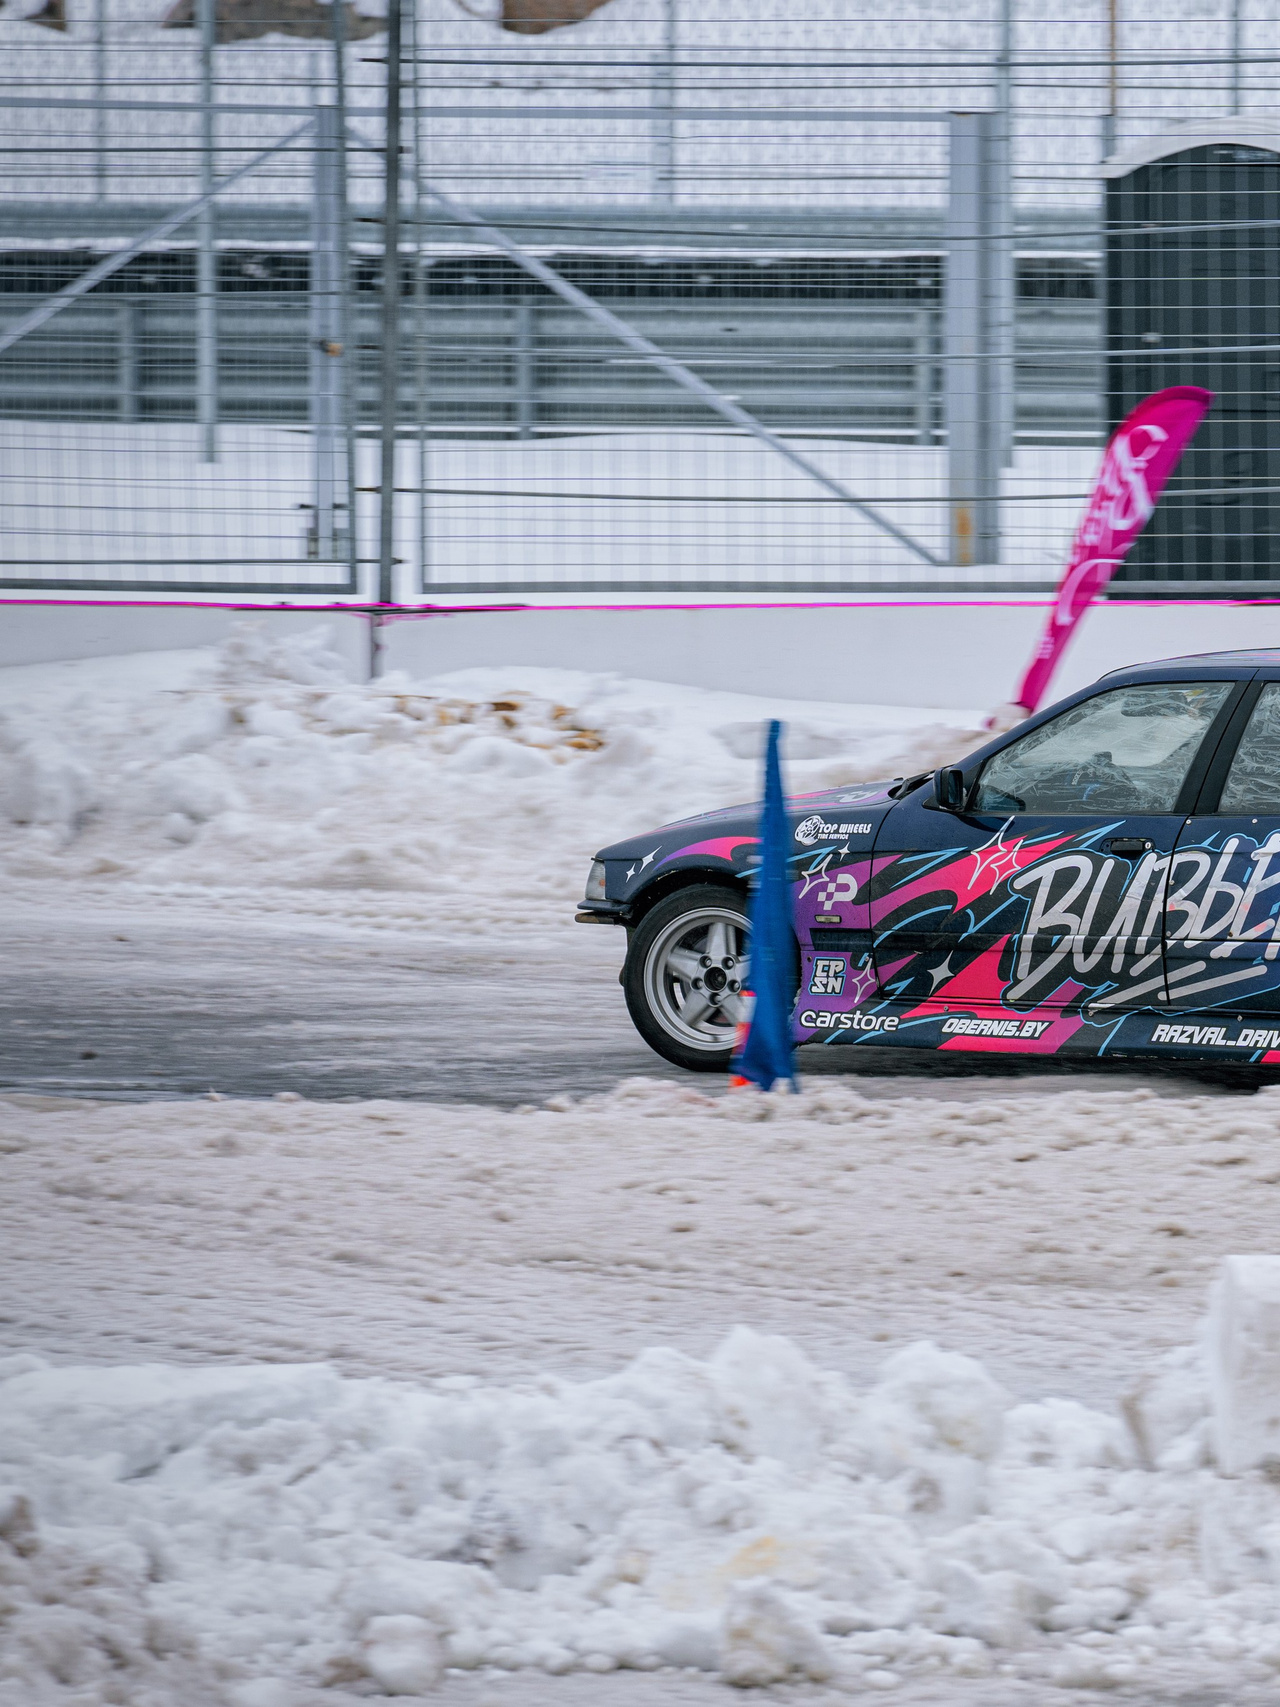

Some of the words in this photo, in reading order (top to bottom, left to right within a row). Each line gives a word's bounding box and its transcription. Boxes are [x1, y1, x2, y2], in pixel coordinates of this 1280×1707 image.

[819, 823, 838, 833] TOP
[838, 823, 872, 834] WHEELS
[800, 1009, 900, 1031] carstore
[942, 1018, 1049, 1038] OBERNIS.BY
